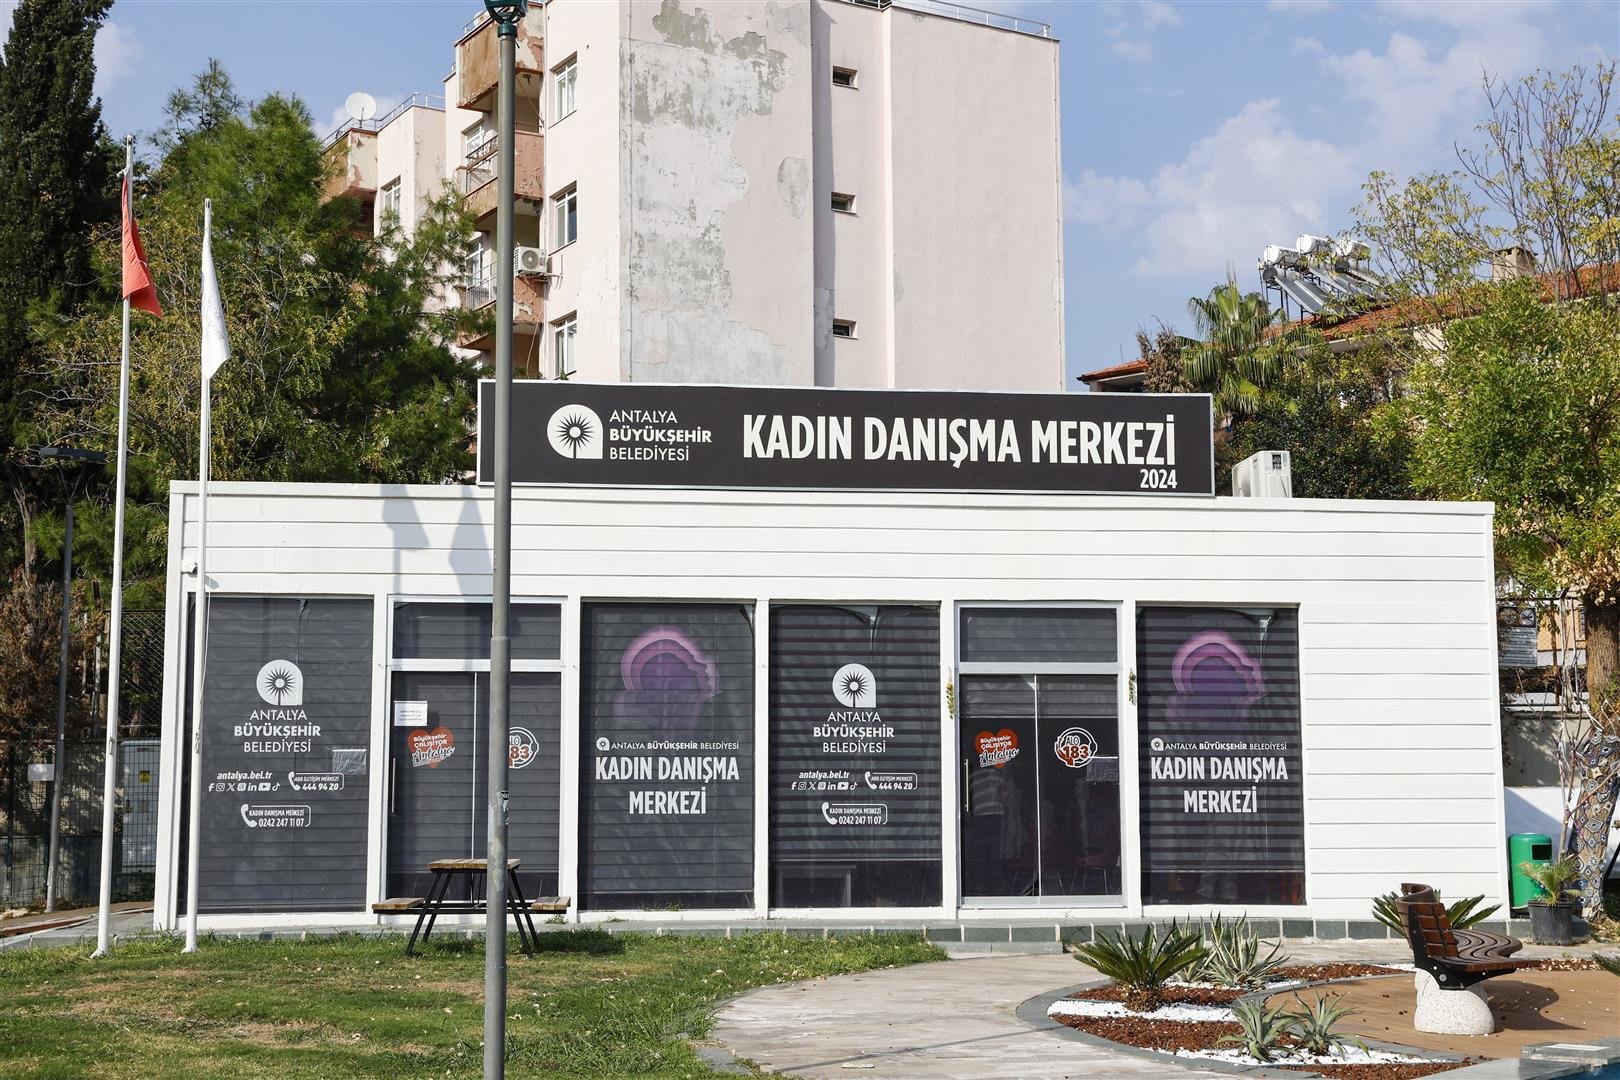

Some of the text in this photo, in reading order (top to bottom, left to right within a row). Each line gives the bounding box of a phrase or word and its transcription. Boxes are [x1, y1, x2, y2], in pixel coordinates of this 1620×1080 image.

[609, 409, 678, 423] ANTALYA
[609, 425, 712, 445] BÜYÜKŞEHİR
[743, 414, 1175, 469] KADIN DANIŞMA MERKEZİ
[609, 444, 690, 461] BELEDİYESİ
[1139, 468, 1178, 489] 2024
[250, 709, 307, 721] ANTALYA
[827, 711, 881, 722] ANTALYA
[234, 722, 321, 739] BÜYÜKŞEHİR
[813, 724, 895, 740] BÜYÜKŞEHİR
[244, 739, 311, 753] BELEDİYESİ
[508, 744, 530, 761] 83
[611, 740, 739, 751] ANTALYA BÜYÜKŞEHİR BELEDİYESİ
[823, 740, 886, 753] BELEDİYESİ
[1061, 744, 1090, 760] 183
[1165, 741, 1287, 751] ANTALYA BÜYÜKŞEHİR BELEDİYESİ
[411, 745, 456, 763] Antalya
[979, 746, 1020, 763] Antalya
[216, 770, 273, 781] antalya.bel.tr
[595, 756, 740, 784] KADIN DANIŞMA
[799, 770, 850, 780] antalya.bel.tr
[1151, 756, 1288, 783] KADIN DANIŞMA
[879, 782, 913, 790] 444 94 20
[629, 786, 707, 815] MERKEZİ
[1184, 786, 1258, 813] MERKEZİ
[258, 818, 275, 827] 0242
[276, 818, 288, 827] 247
[838, 816, 854, 824] 0242
[855, 816, 866, 824] 247
